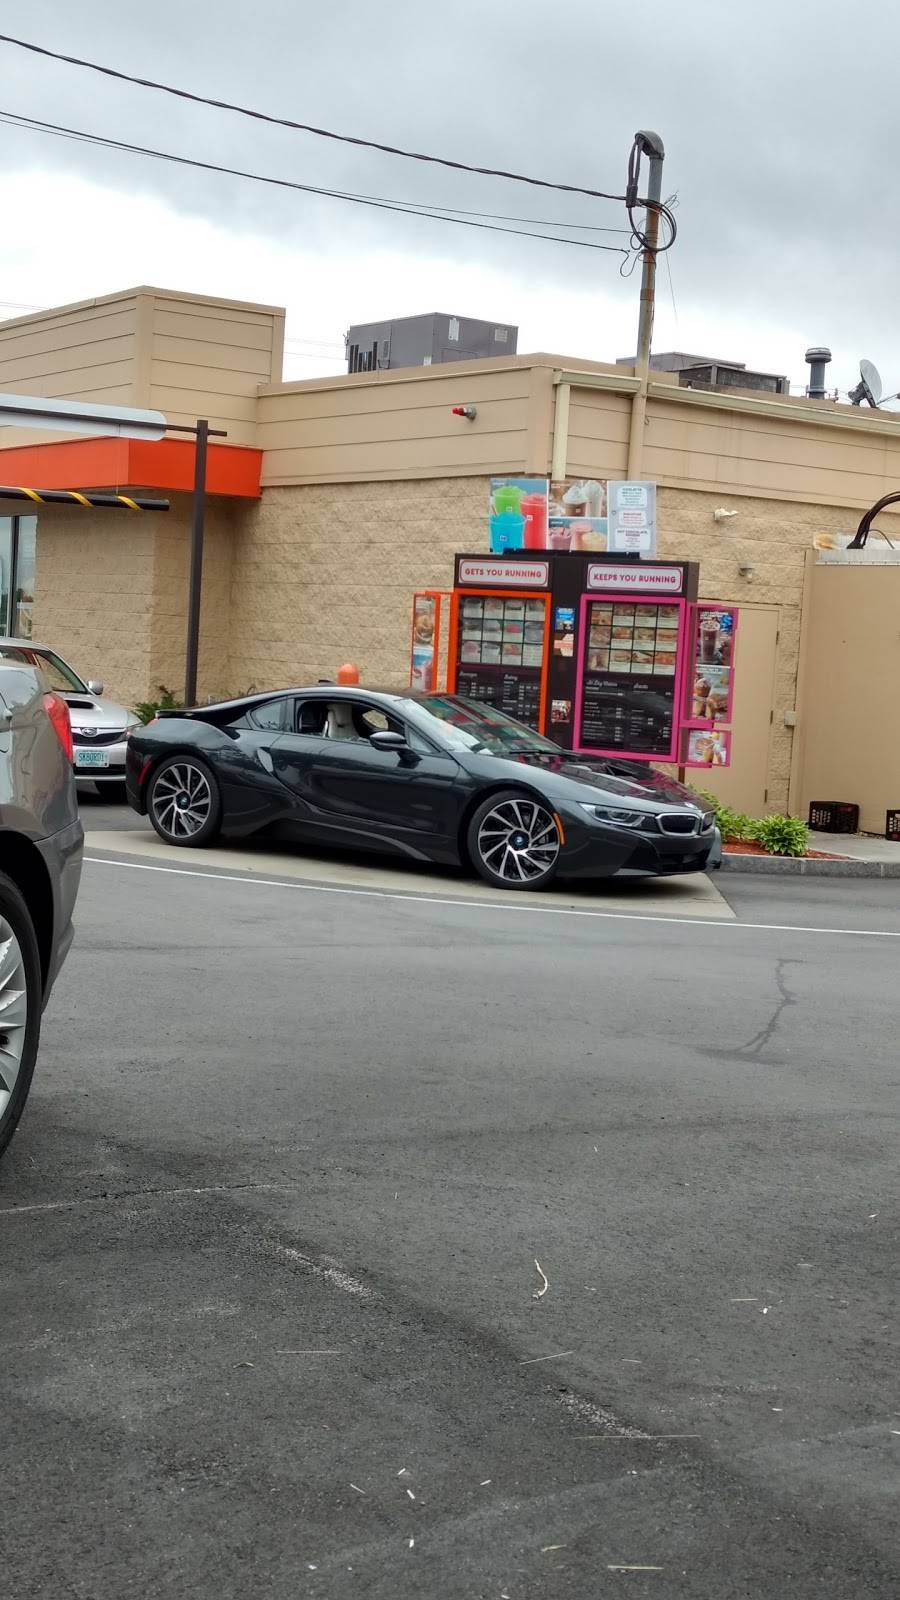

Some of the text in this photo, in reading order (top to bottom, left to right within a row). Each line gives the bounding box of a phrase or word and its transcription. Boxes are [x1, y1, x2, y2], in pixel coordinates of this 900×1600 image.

[464, 568, 542, 578] GETS YOU RUNNING
[593, 573, 676, 584] KEEPS YOU RUNNING
